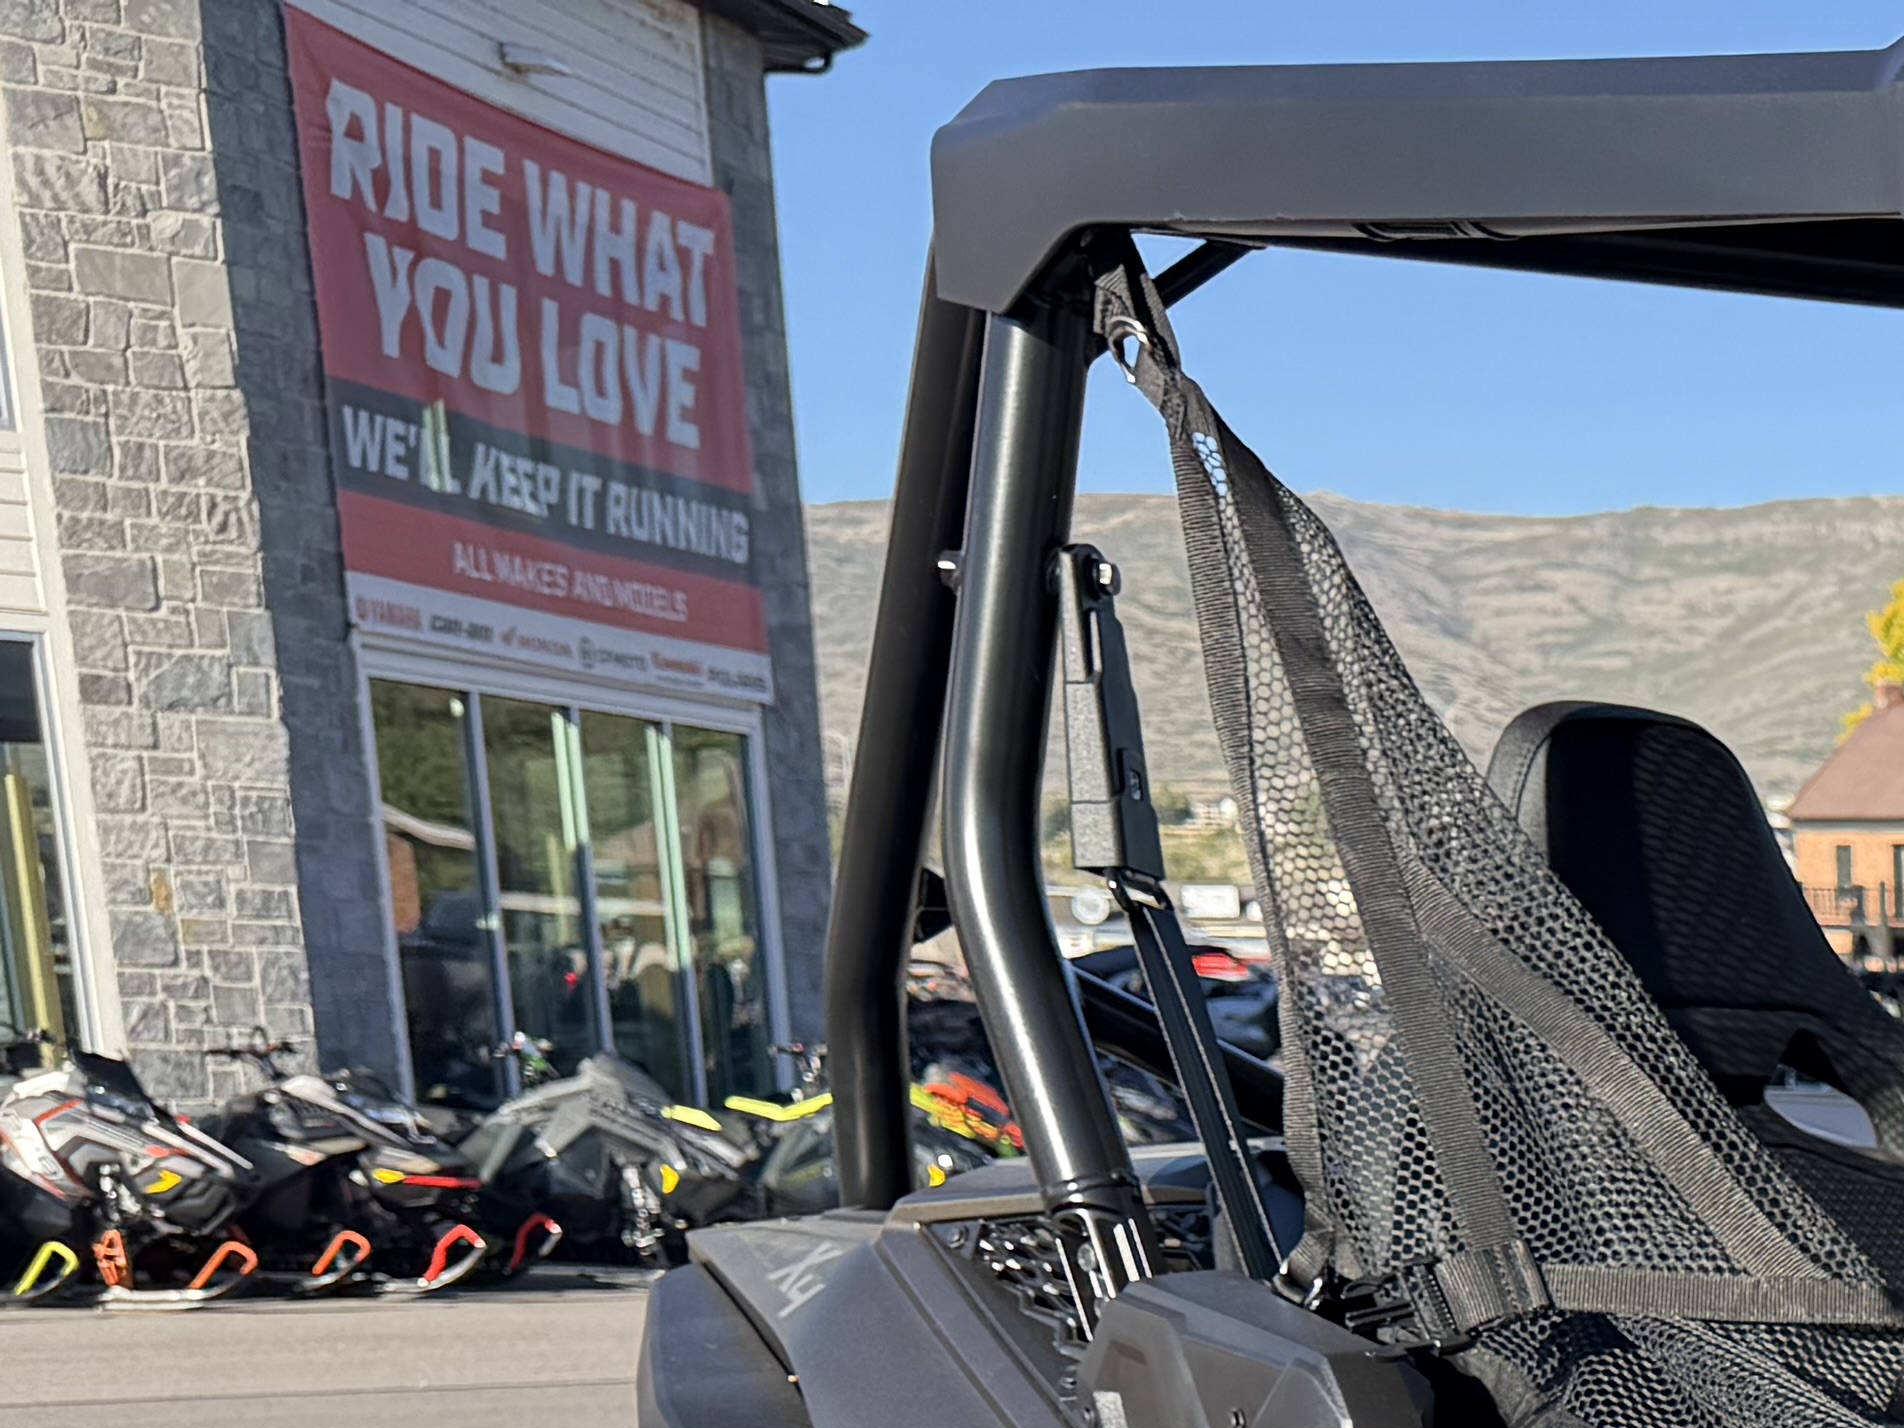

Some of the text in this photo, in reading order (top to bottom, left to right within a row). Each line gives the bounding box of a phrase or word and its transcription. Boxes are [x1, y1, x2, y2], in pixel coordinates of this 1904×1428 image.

[327, 78, 715, 328] RIDE WHAT
[364, 231, 701, 450] YOU LOVE
[453, 540, 689, 623] ALL MAKES AND MODELS
[468, 442, 561, 517] KEEP
[567, 471, 604, 530] IT
[606, 482, 750, 565] RUNNING
